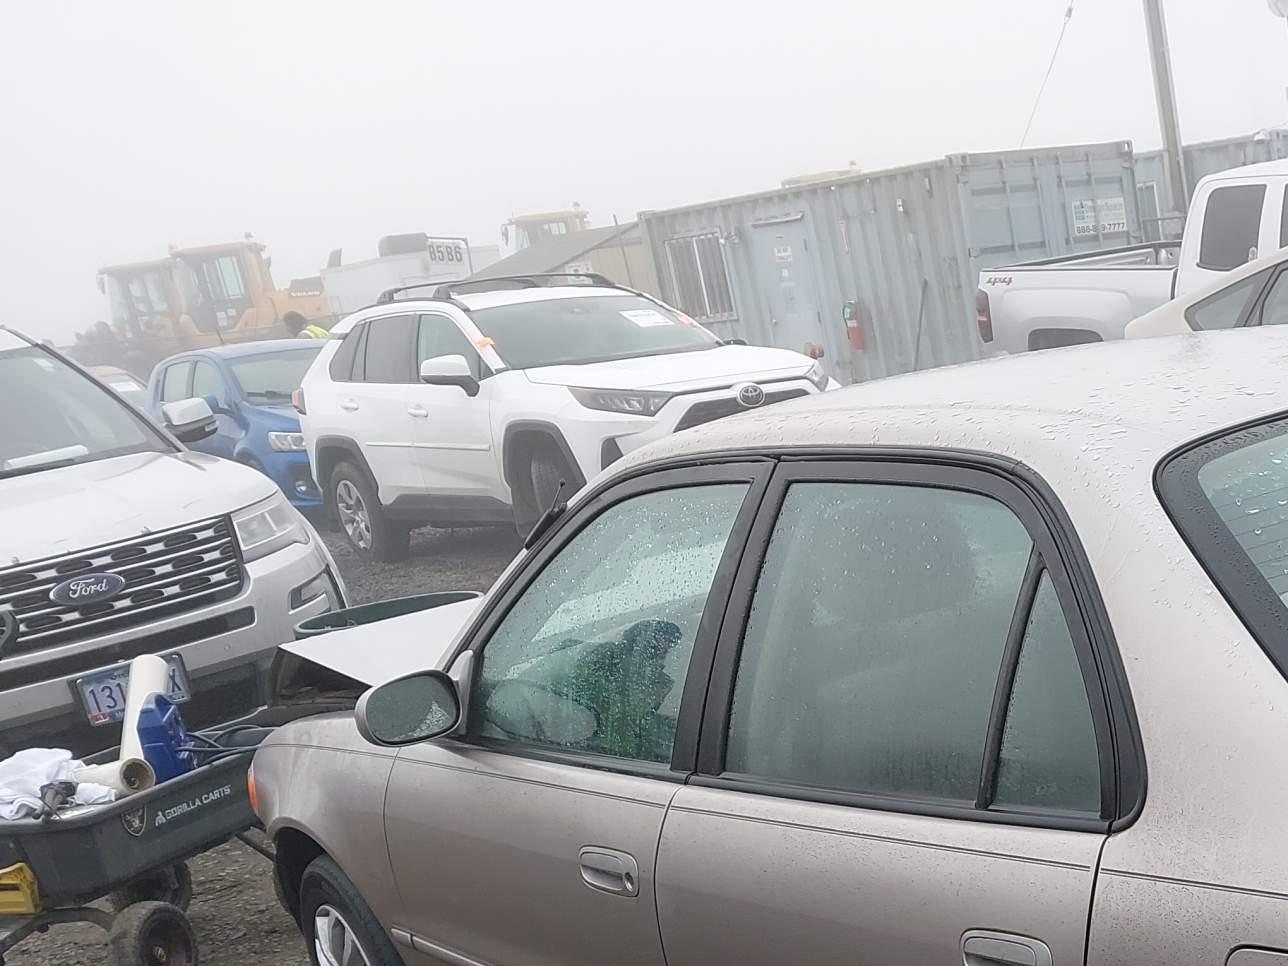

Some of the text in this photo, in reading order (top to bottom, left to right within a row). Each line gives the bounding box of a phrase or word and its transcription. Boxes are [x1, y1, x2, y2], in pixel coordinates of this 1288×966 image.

[69, 578, 108, 598] Ford
[165, 785, 231, 819] GORILLA CARTS
